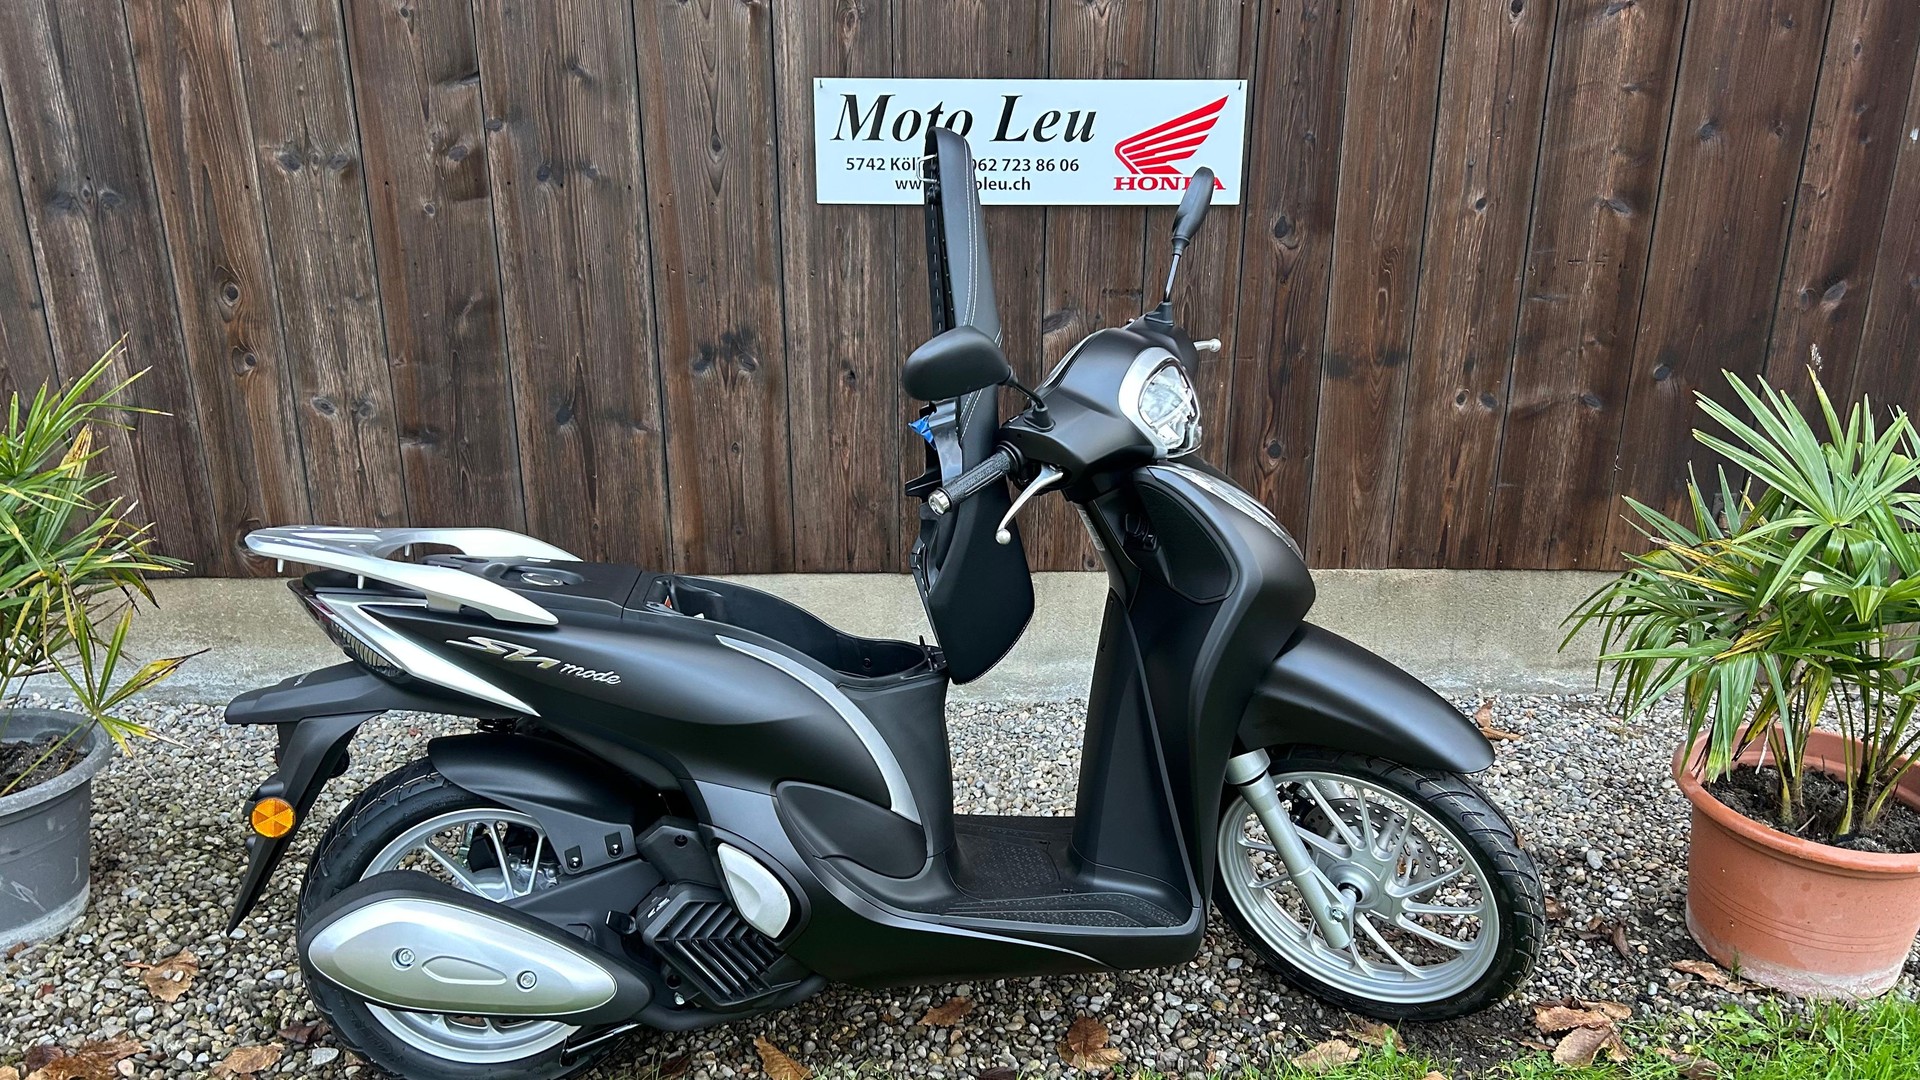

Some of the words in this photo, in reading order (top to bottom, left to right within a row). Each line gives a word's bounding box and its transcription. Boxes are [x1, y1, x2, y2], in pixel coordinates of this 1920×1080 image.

[830, 94, 974, 142] Moto
[989, 95, 1097, 143] Leu
[846, 157, 886, 171] 5742
[1001, 158, 1031, 172] 723
[1036, 158, 1055, 172] 86
[1060, 158, 1079, 172] 06
[559, 662, 622, 685] mode
